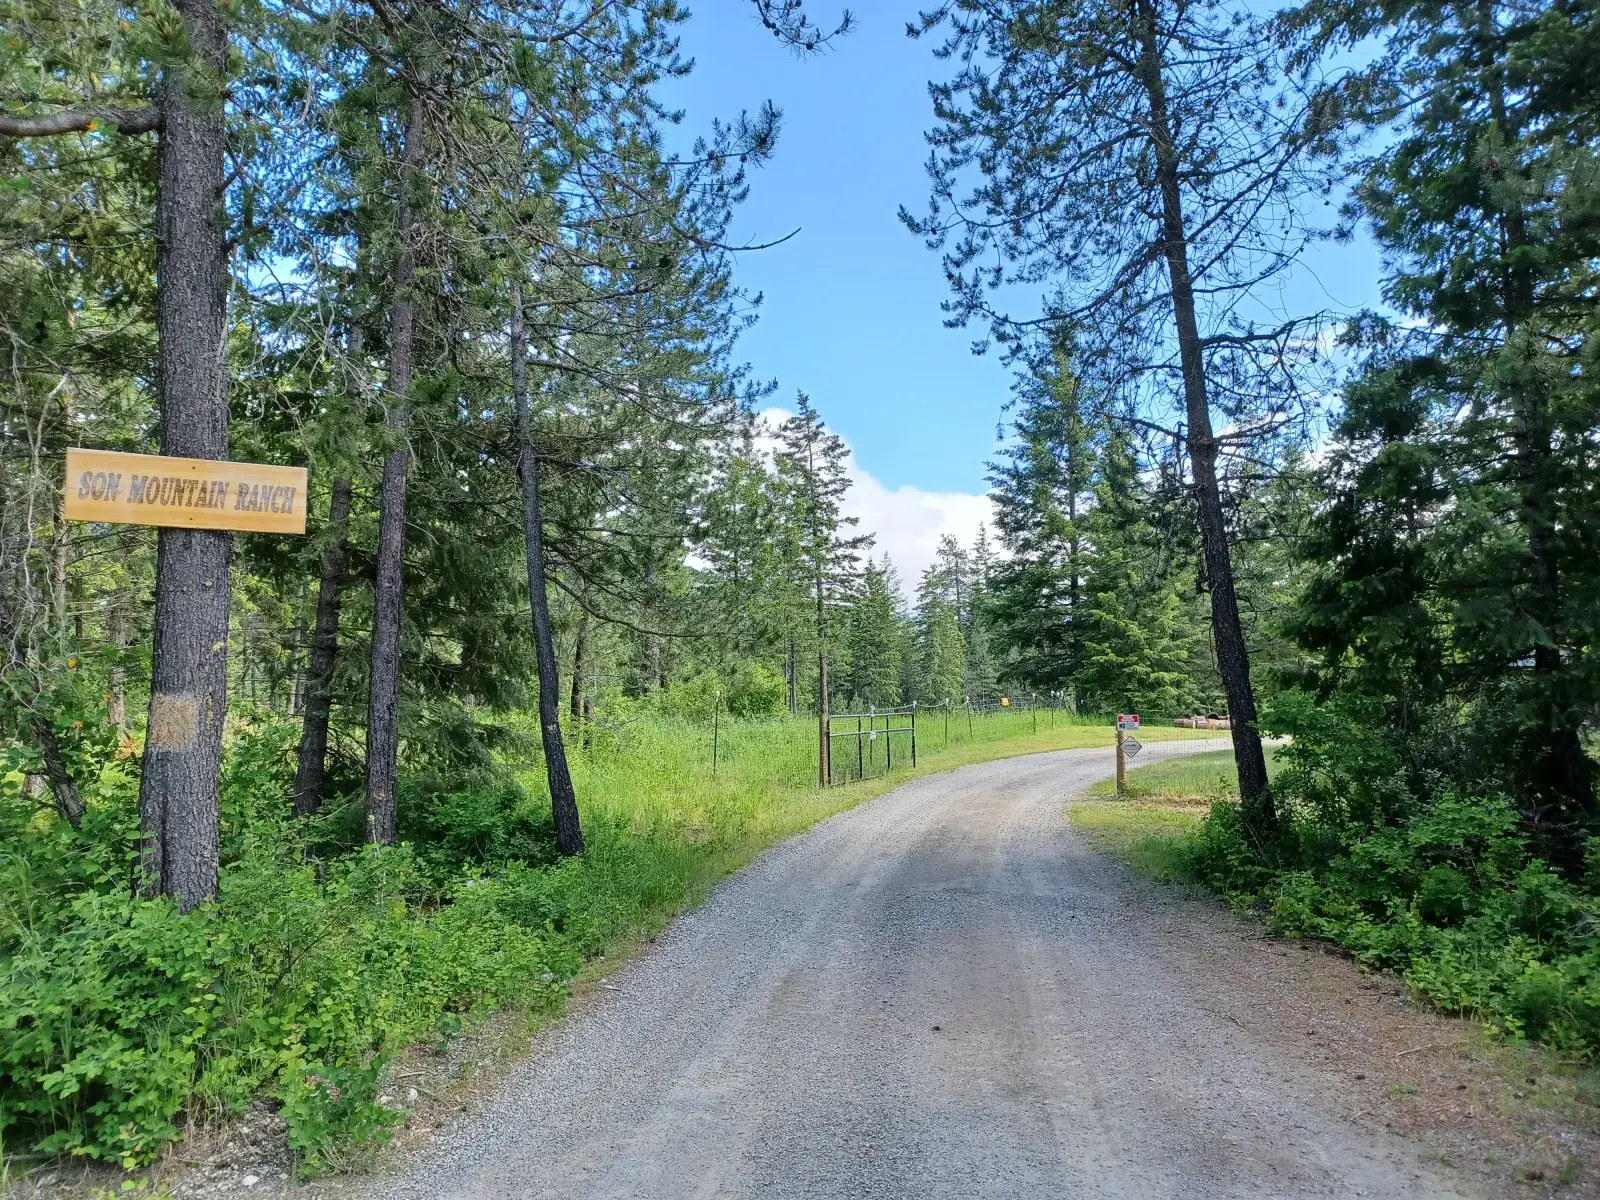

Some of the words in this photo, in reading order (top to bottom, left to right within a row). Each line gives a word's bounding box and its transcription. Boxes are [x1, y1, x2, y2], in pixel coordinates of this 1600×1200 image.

[78, 470, 121, 502] SON
[127, 474, 230, 510] MOUNTAIN
[234, 482, 296, 514] RANCH
